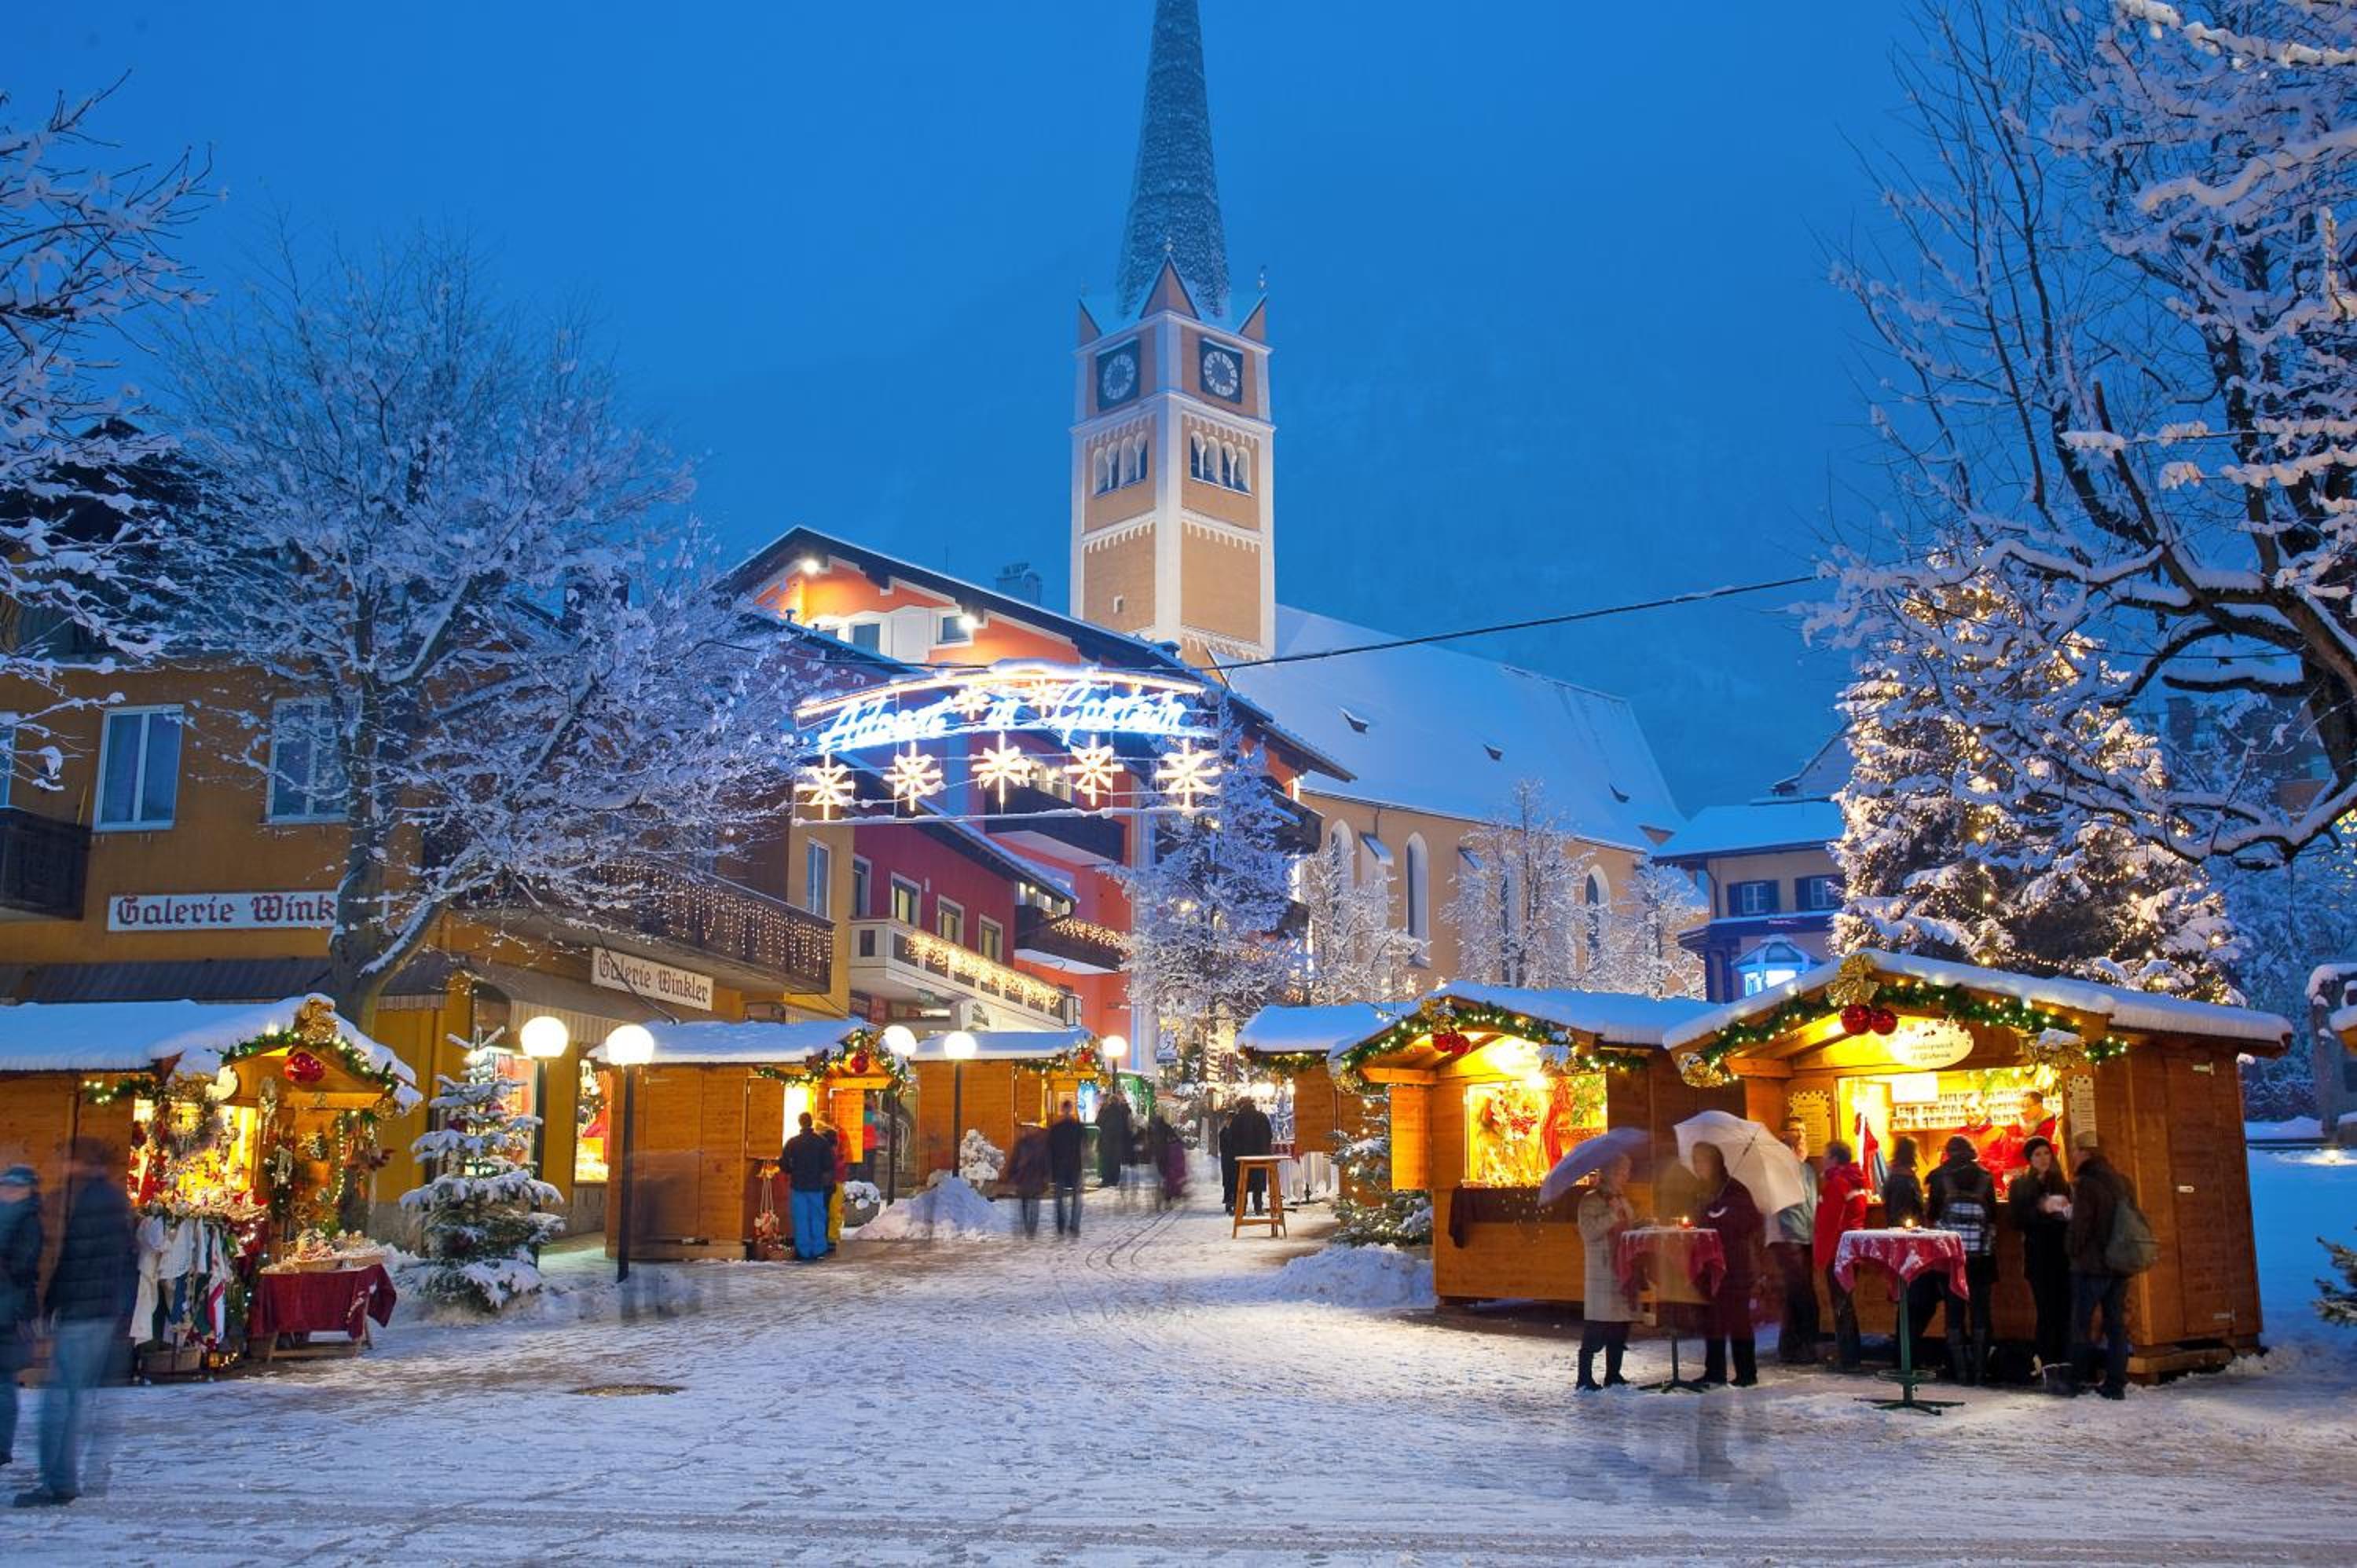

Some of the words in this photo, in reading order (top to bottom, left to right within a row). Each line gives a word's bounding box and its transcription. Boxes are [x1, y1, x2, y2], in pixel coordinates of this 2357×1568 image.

[117, 896, 236, 925] Galerie
[251, 894, 336, 923] Wink
[598, 952, 651, 989] Galerie
[658, 967, 708, 1003] Winkler
